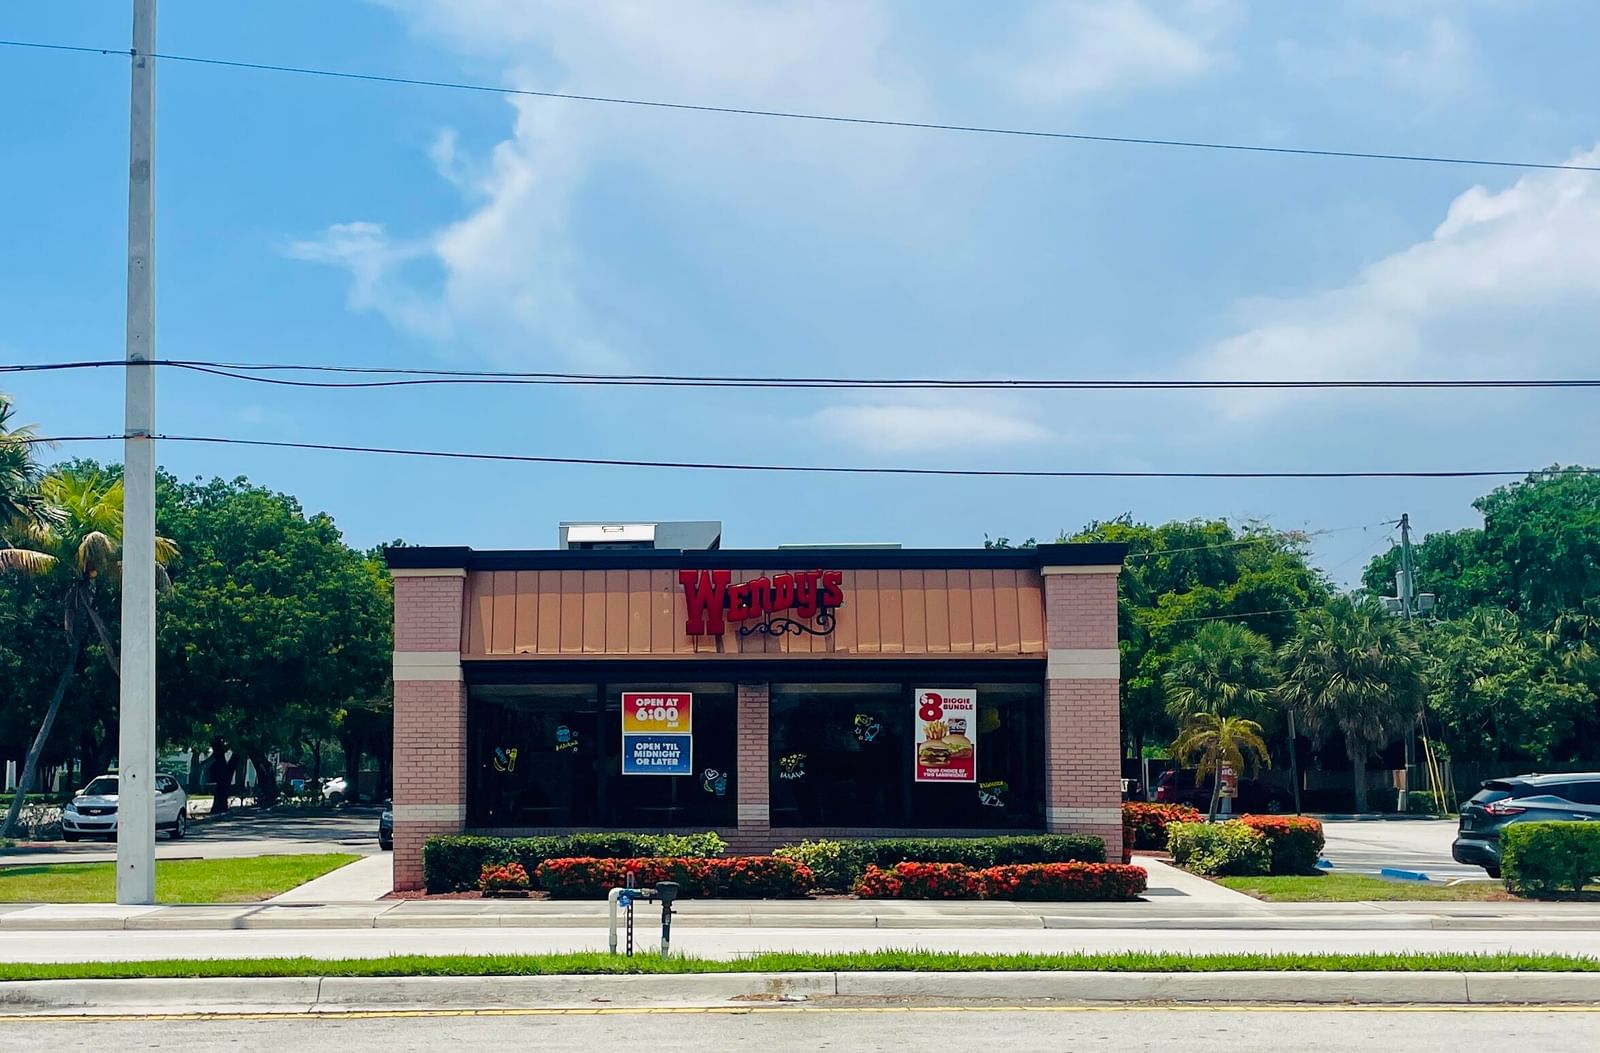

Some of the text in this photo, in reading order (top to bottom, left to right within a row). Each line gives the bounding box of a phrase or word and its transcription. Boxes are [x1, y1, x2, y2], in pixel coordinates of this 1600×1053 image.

[636, 698, 679, 706] OPEN AT
[636, 707, 679, 721] 6:00
